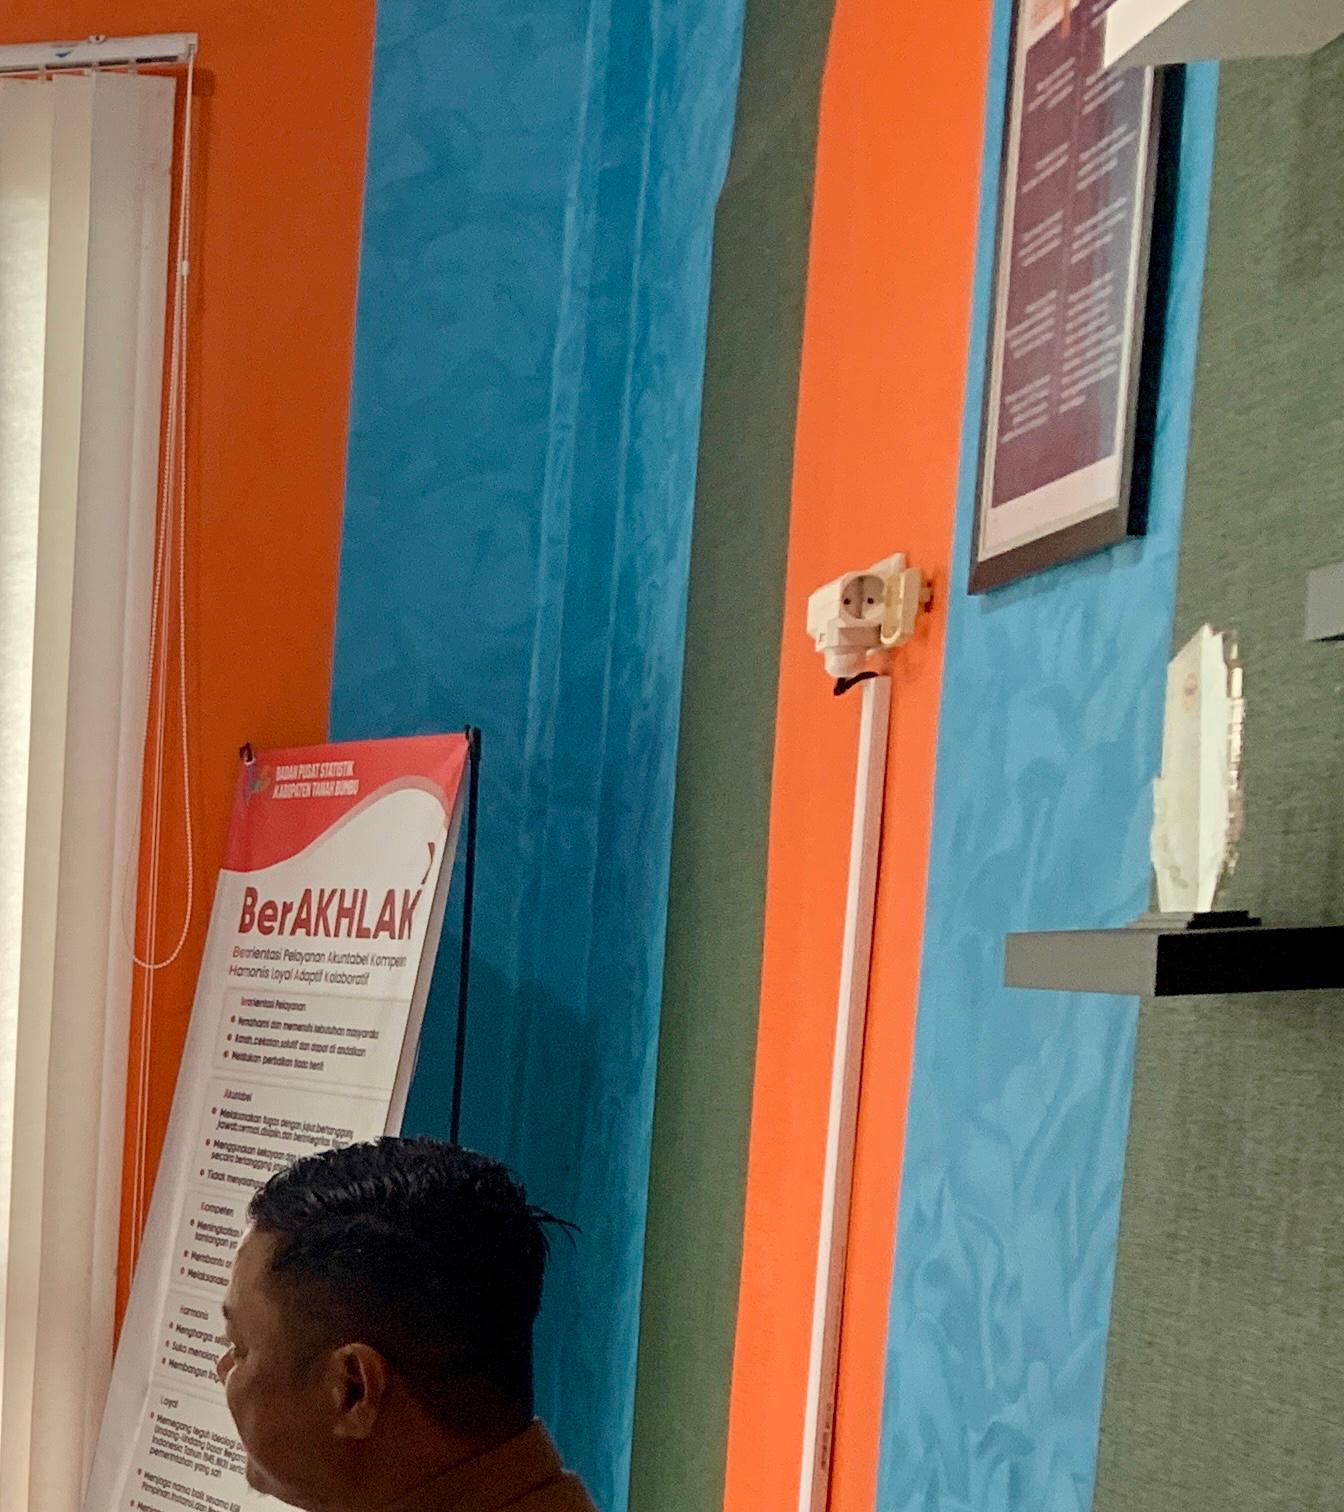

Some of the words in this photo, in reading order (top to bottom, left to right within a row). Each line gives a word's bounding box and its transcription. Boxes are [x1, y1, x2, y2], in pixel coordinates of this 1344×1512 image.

[238, 886, 422, 940] BerAKHLAK
[283, 949, 326, 965] Pelayanan
[328, 950, 369, 966] Akuntabel
[271, 966, 293, 983] Loyal
[294, 968, 324, 986] Adaptif
[324, 971, 370, 986] Kolaboratif
[160, 1396, 179, 1408] Loyal
